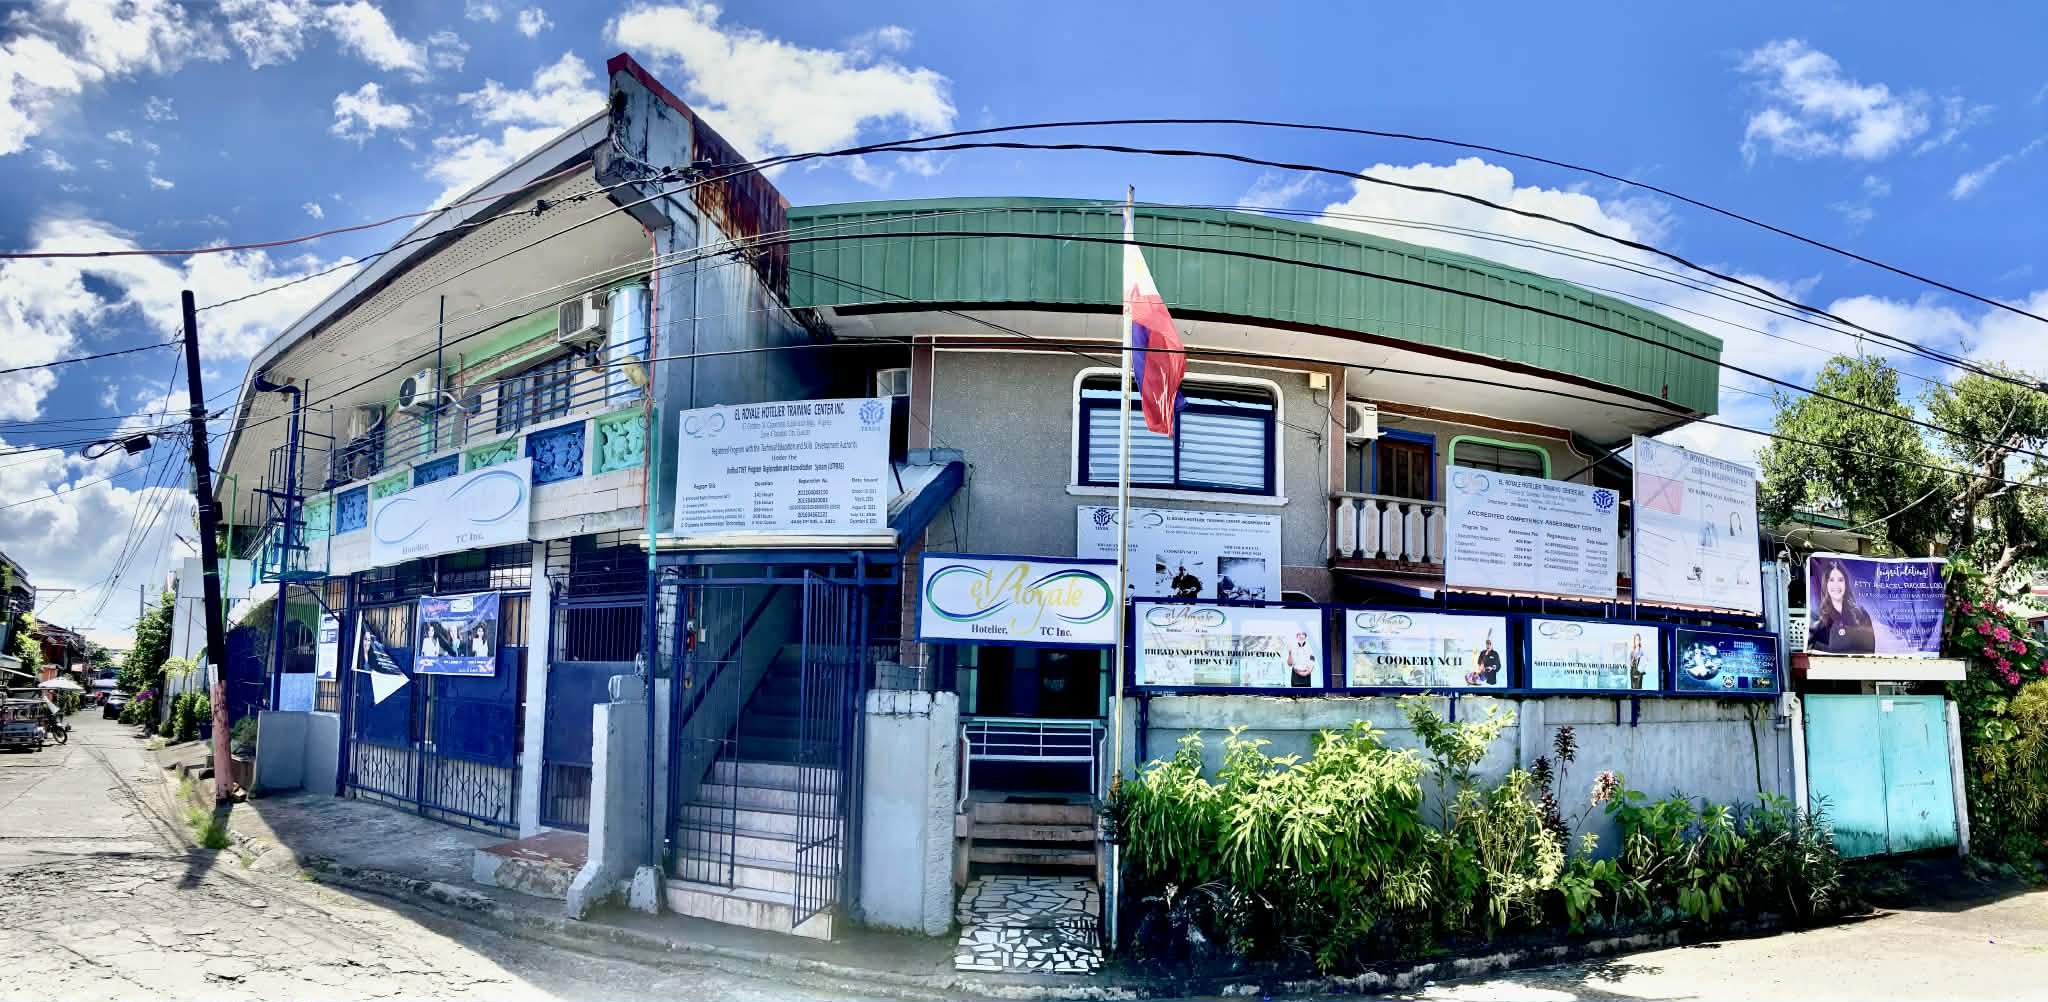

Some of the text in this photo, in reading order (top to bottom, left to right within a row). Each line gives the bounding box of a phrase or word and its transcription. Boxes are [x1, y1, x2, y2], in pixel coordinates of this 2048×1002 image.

[742, 407, 760, 420] ROYALE
[762, 405, 786, 419] HOTELIER
[787, 404, 812, 417] TRAINING
[814, 402, 834, 416] CENTER
[1467, 510, 1505, 520] ACCREDITED
[1040, 626, 1054, 636] TC
[1056, 627, 1072, 637] Inc.
[1144, 648, 1174, 656] BREAD
[1175, 648, 1192, 656] AND
[1227, 650, 1281, 658] PRODUCTION
[1377, 655, 1435, 666] COOKERY
